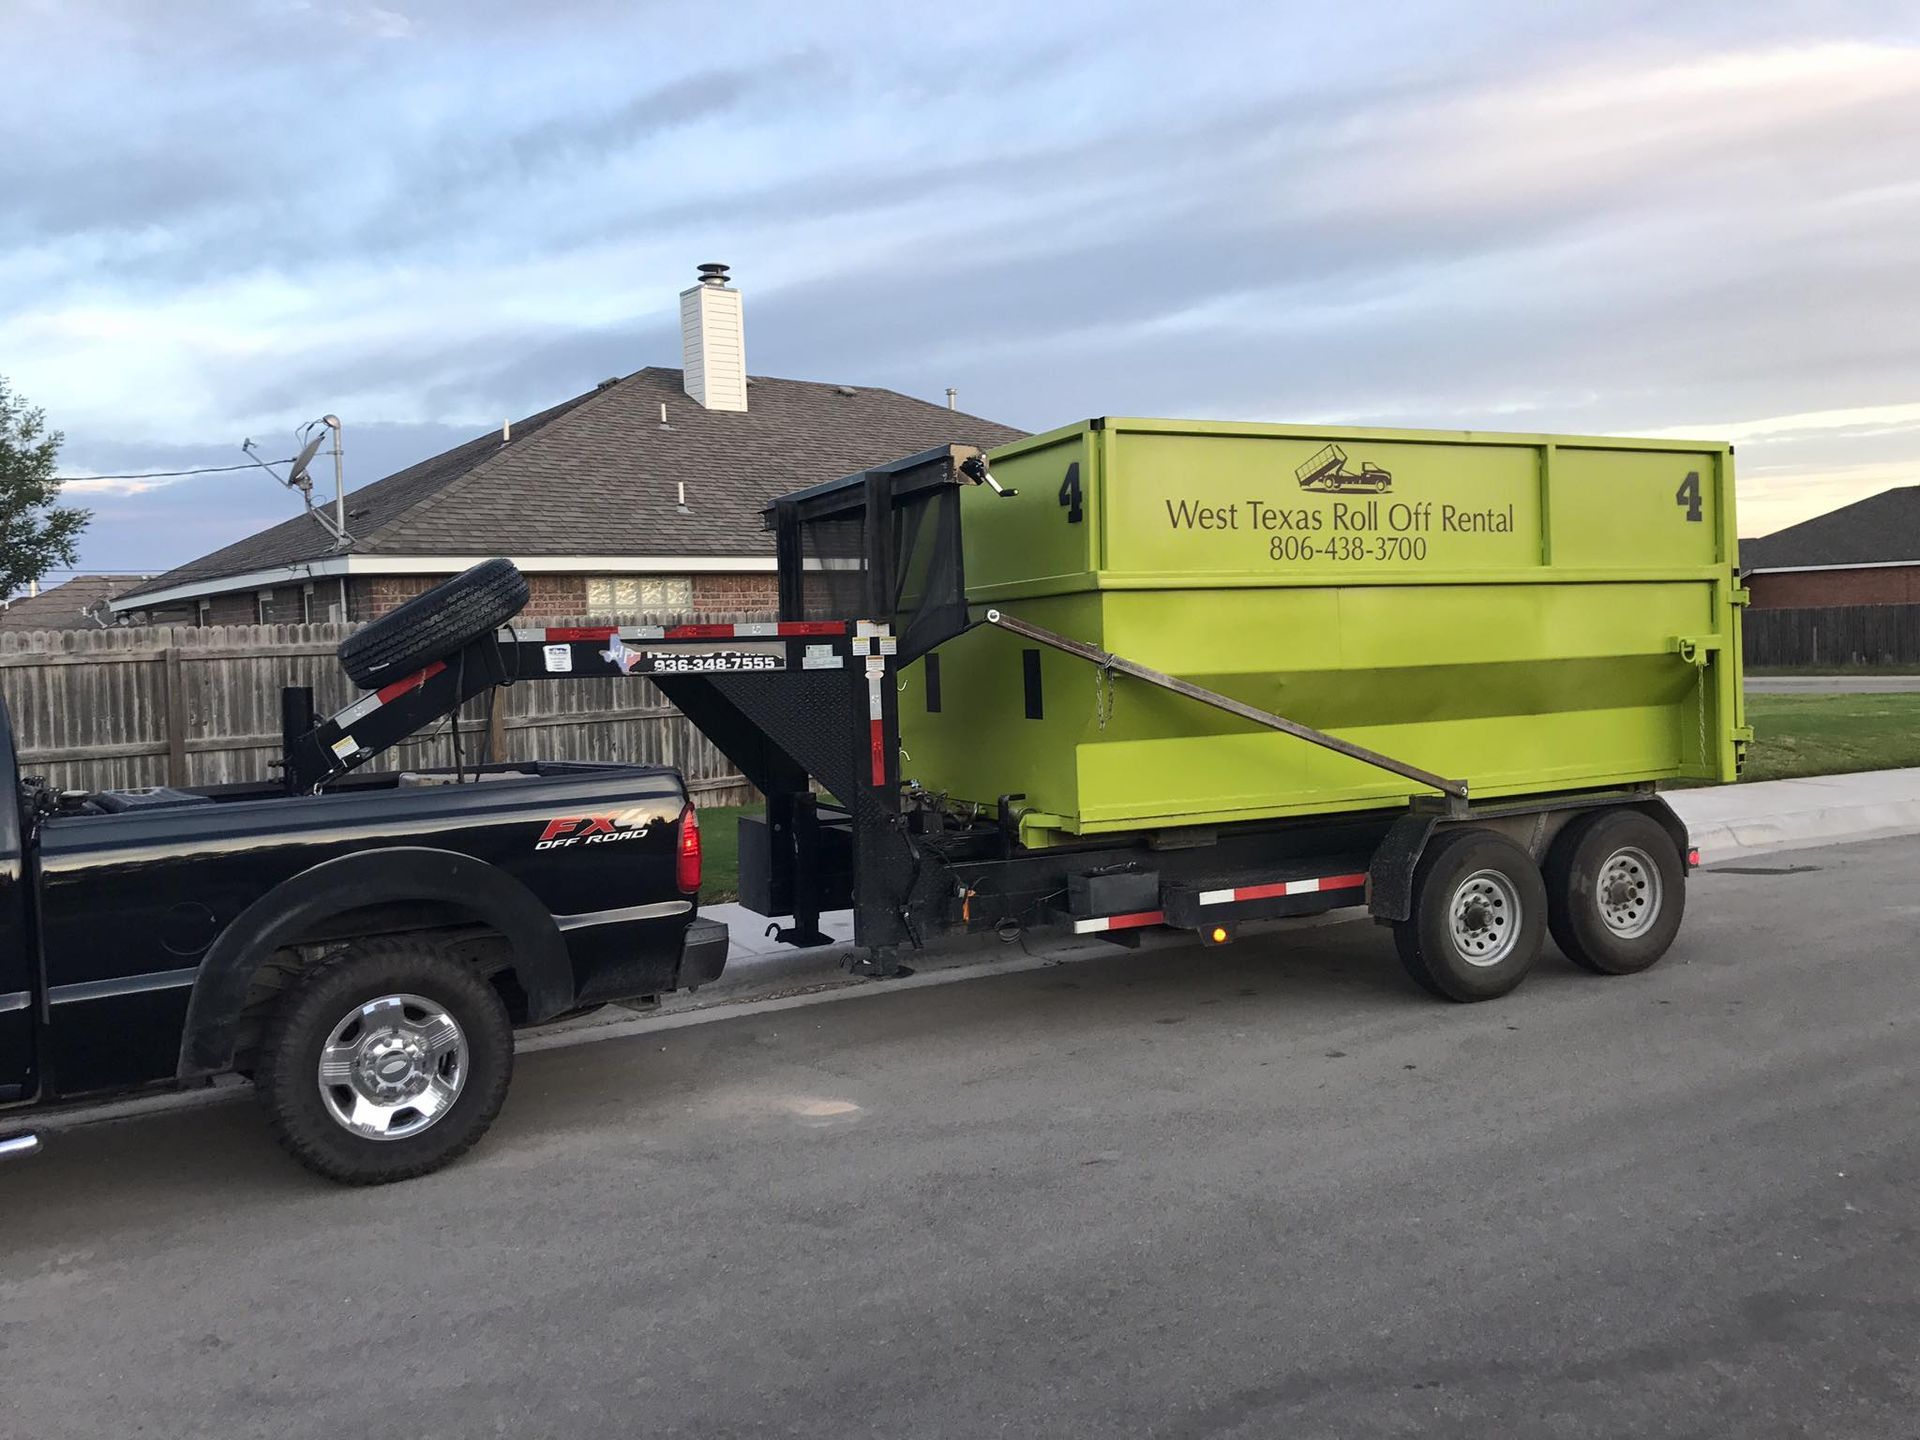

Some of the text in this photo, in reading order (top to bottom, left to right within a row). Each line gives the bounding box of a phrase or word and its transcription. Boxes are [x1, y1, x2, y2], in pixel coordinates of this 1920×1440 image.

[1059, 462, 1082, 523] 4
[1676, 471, 1702, 522] 4
[1165, 499, 1514, 533] West Texas Roll Off Rental
[1269, 535, 1427, 561] 806-438-3700
[653, 656, 776, 673] 936-348-7555
[534, 829, 649, 851] OFF ROAD
[539, 808, 652, 840] FX4
